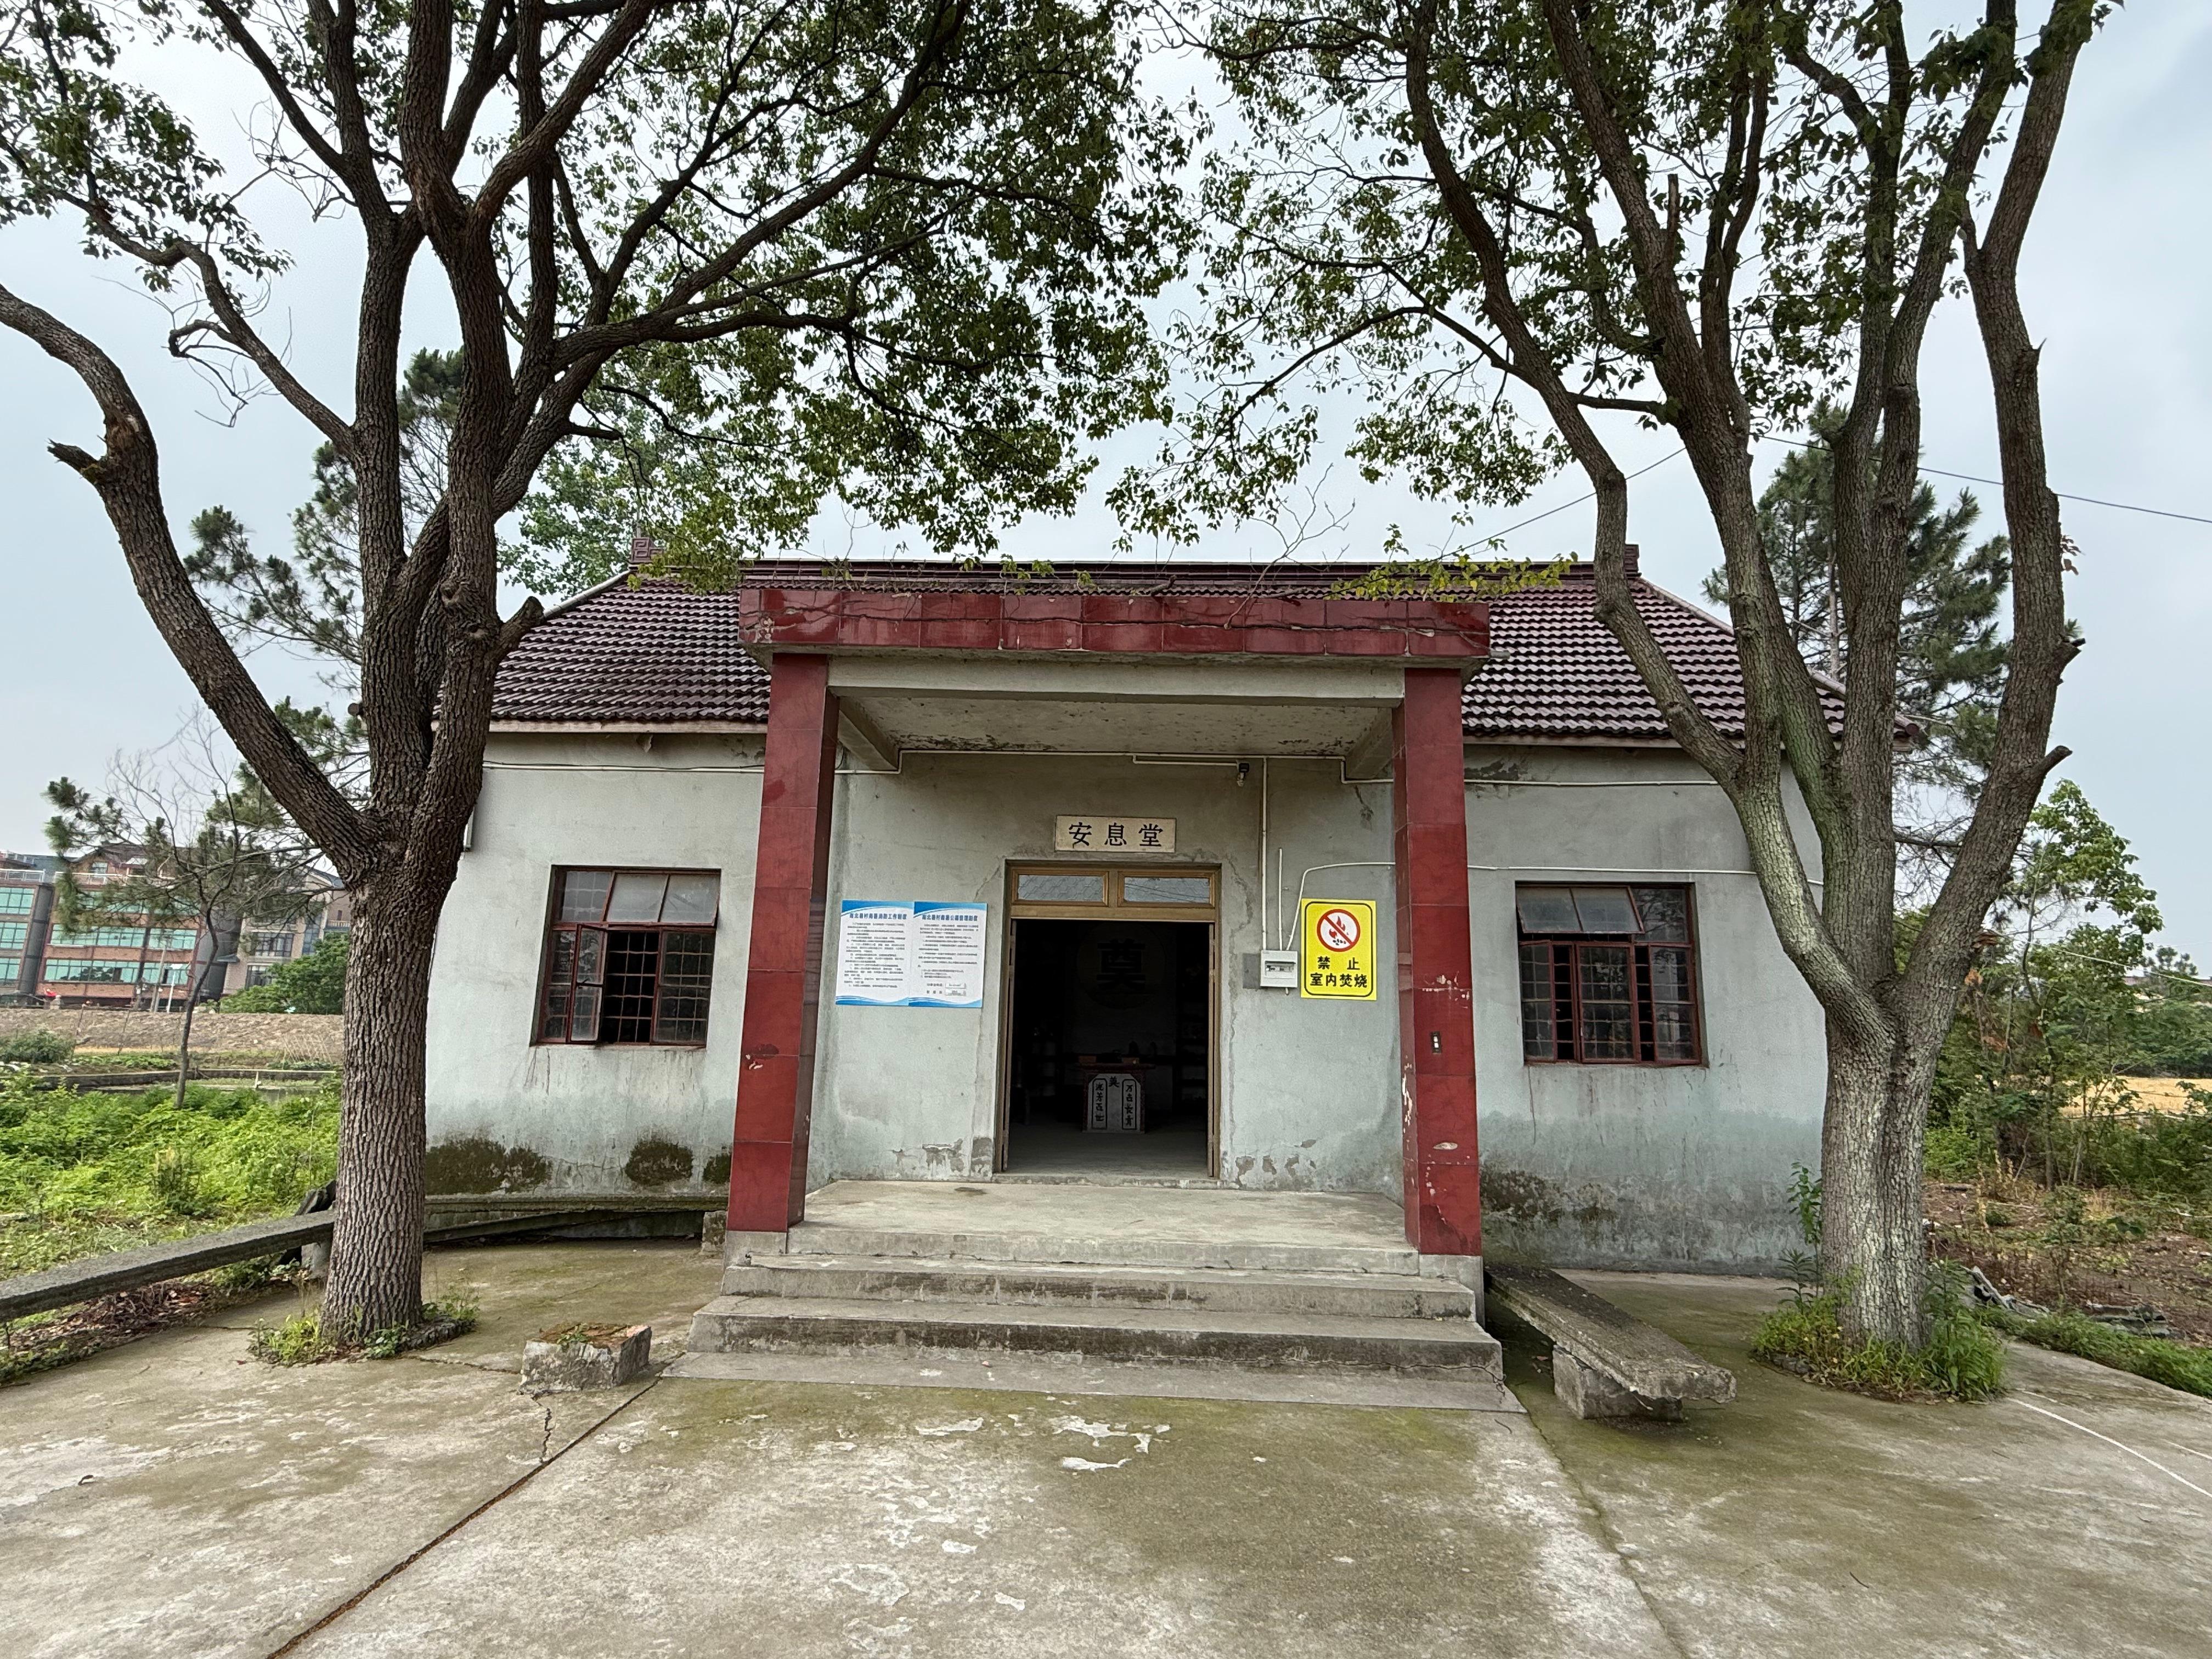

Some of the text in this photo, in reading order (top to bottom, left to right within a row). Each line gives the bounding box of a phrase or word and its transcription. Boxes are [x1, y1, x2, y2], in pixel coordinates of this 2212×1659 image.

[1069, 822, 1163, 849] 安息堂
[1317, 956, 1360, 970] 禁止
[1310, 973, 1367, 988] 室内焚烧
[1124, 1084, 1133, 1126] 万古长青
